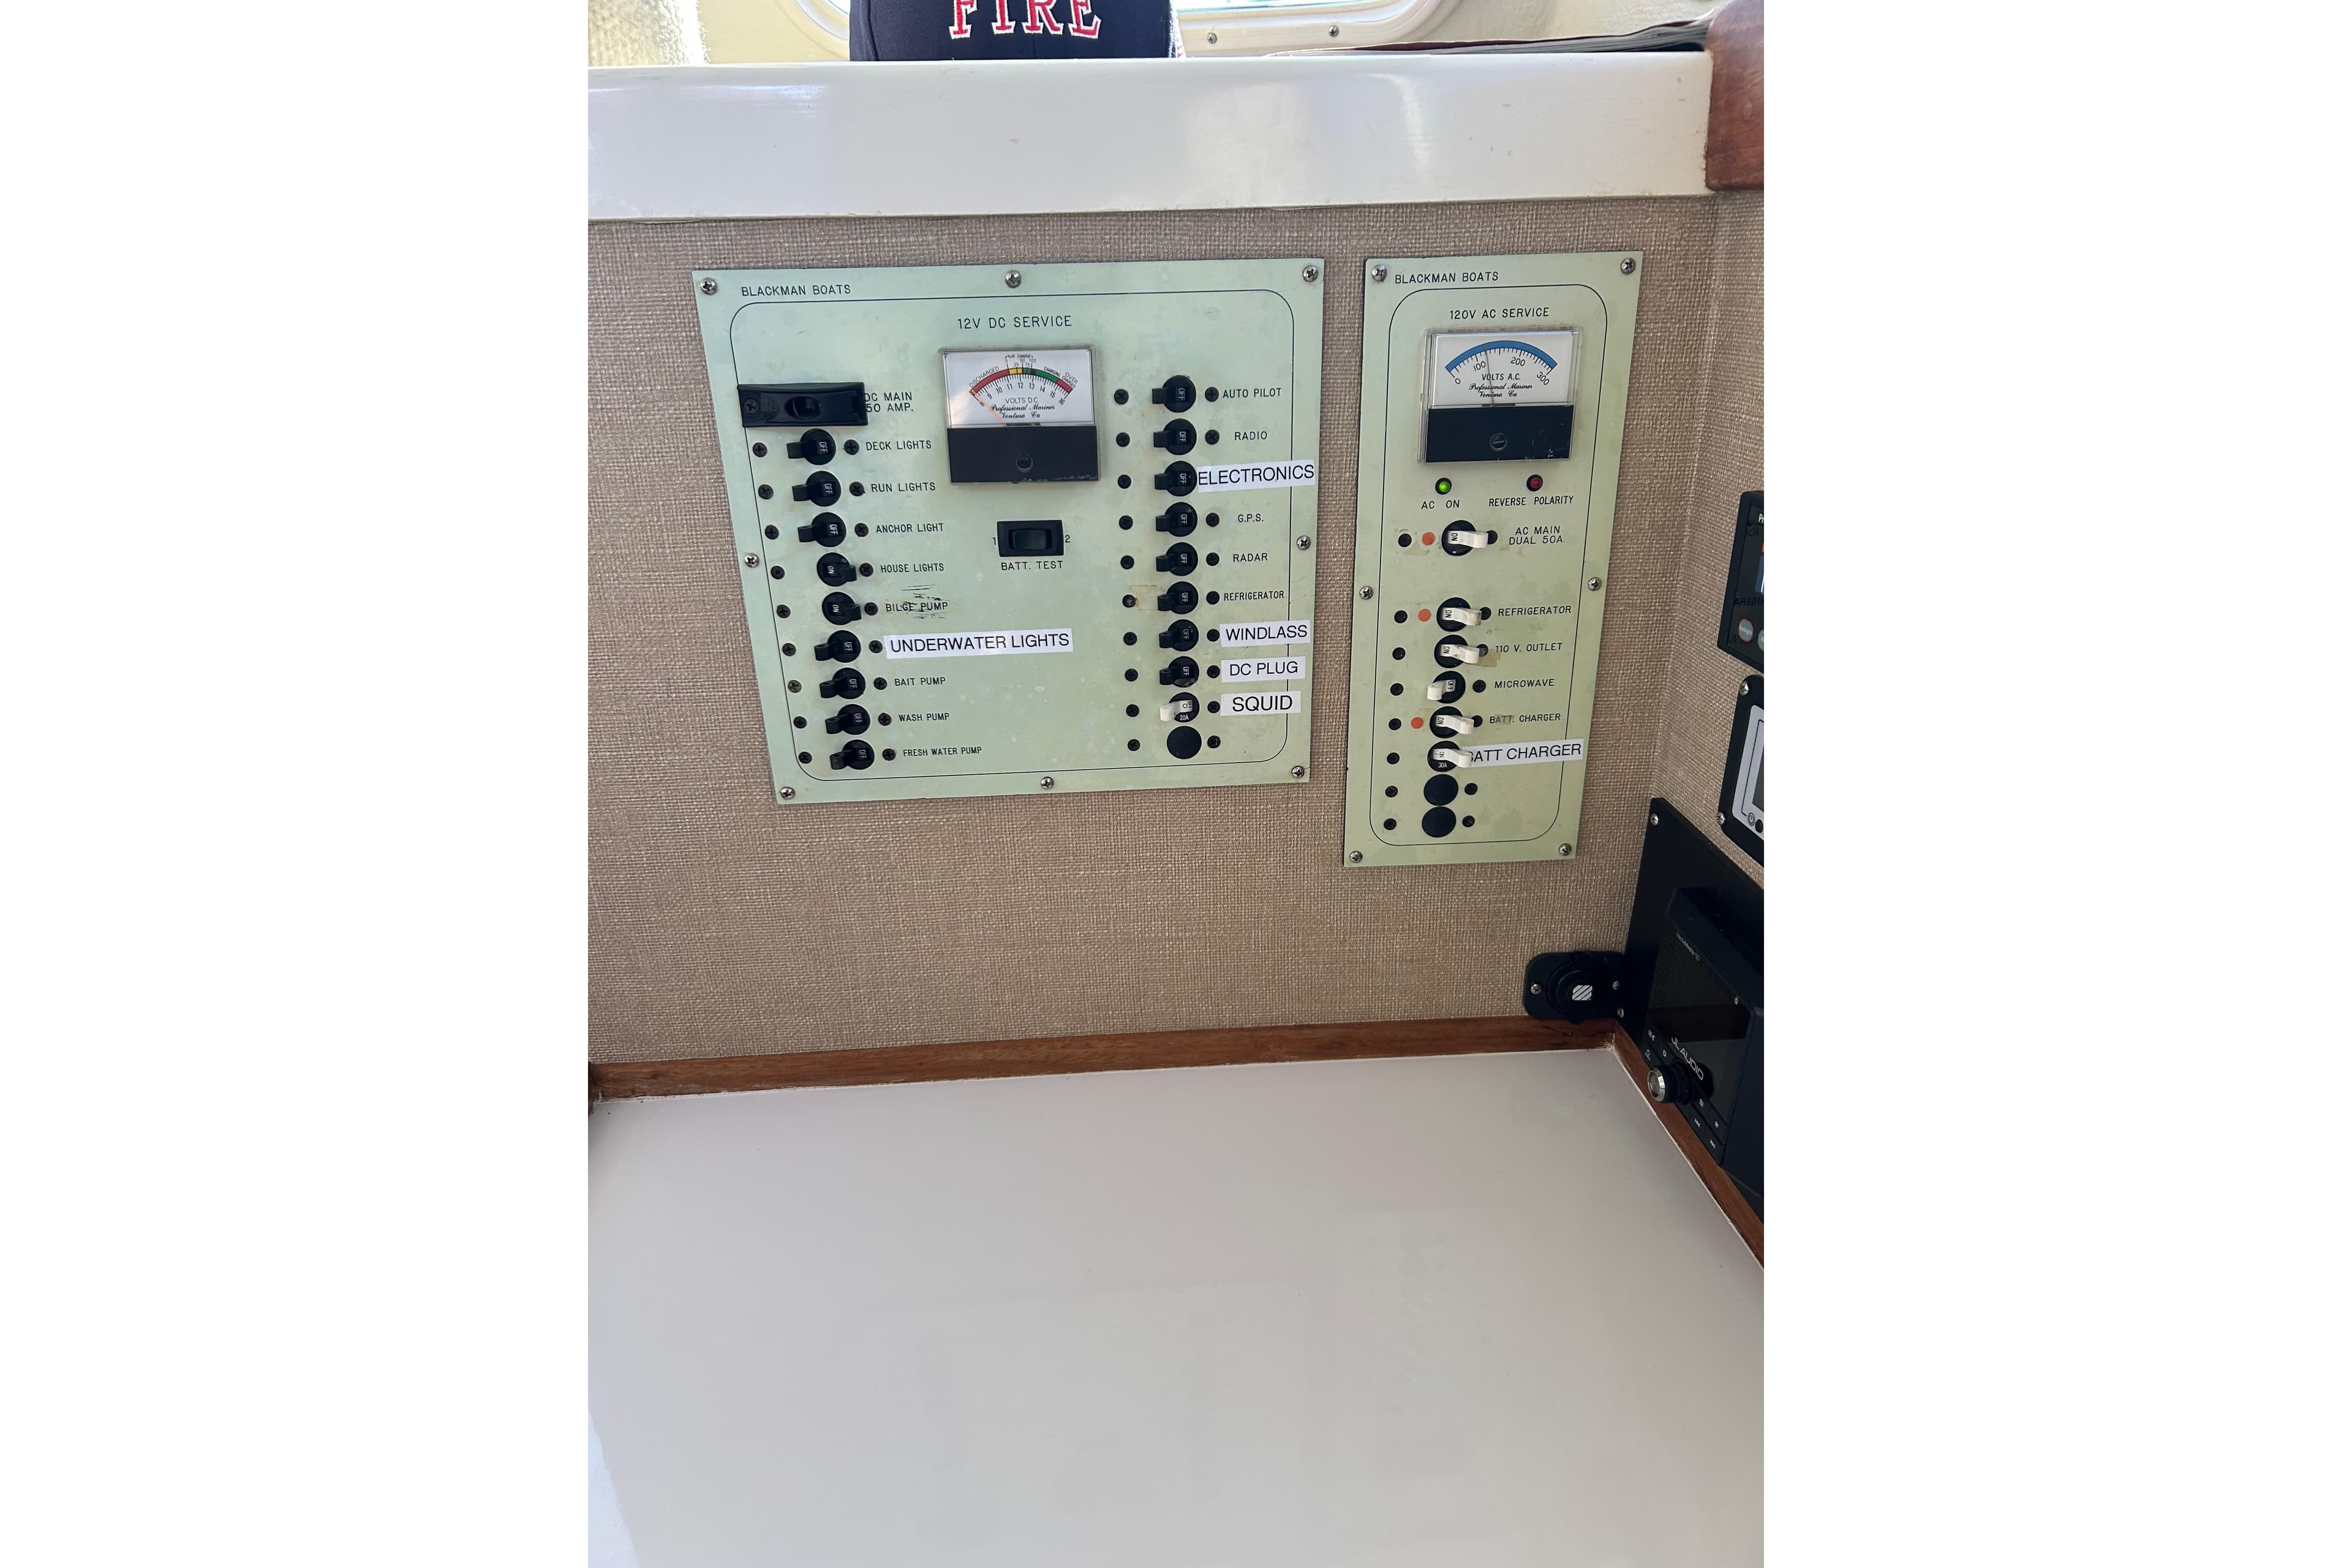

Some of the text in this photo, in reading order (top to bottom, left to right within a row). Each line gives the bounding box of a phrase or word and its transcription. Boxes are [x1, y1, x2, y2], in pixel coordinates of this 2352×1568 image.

[949, 0, 1102, 39] FIRE
[1395, 271, 1499, 284] BLACKMAN BOATS
[741, 284, 851, 297] BLACKMAN BOATS
[1450, 307, 1550, 320] 120V AC SERVICE
[957, 315, 1072, 329] 12V DC SERVICE
[1473, 361, 1486, 371] 100
[1510, 356, 1526, 366] 200
[969, 366, 1000, 388] DISCHARGED
[1065, 372, 1079, 385] OVER
[1536, 371, 1550, 385] 300
[1469, 383, 1507, 392] Professional
[864, 391, 913, 402] DC MAIN
[1223, 388, 1282, 398] AUTO PILOT
[887, 402, 914, 412] AMP.
[990, 404, 1028, 412] Professional
[1234, 431, 1267, 440] RADIO
[819, 441, 828, 453] OFF
[866, 440, 932, 451] DECK LIGHTS
[1198, 464, 1314, 486] ELECTRONICS
[824, 483, 833, 495] OFF
[871, 482, 936, 492] RUN LIGHTS
[1421, 500, 1460, 510] AC ON
[1489, 495, 1574, 507] REVERSE POLARITY
[1238, 513, 1264, 522] G.P.S.
[829, 524, 839, 535] OFF
[876, 522, 944, 533] ANCHOR LIGHT
[1515, 526, 1560, 535] AC MAIN
[992, 537, 997, 545] 1
[1065, 534, 1071, 543] 2
[1451, 532, 1458, 541] ON
[1509, 537, 1536, 545] DUAL
[1233, 552, 1268, 562] RADAR
[827, 565, 835, 575] ON
[881, 563, 944, 573] HOUSE LIGHTS
[1001, 560, 1063, 570] BATT. TEST
[1224, 590, 1284, 601] REFRIGERATOR
[832, 604, 839, 613] ON
[886, 601, 949, 612] BILGE PUMP
[1498, 606, 1572, 616] REFRIGERATOR
[1445, 609, 1452, 618] ON
[1226, 624, 1308, 641] WINDLASS
[891, 633, 1070, 653] UNDERWATER LIGHTS
[1526, 643, 1563, 652] OUTLET
[1442, 646, 1450, 655] ON
[1230, 661, 1298, 676] DC PLUG
[849, 678, 858, 688] OFF
[895, 677, 946, 687] BAIT PUMP
[1494, 679, 1555, 689] MICROWAVE
[1232, 695, 1293, 712] SQUID
[854, 713, 862, 723] OFF
[899, 712, 950, 722] WASH PUMP
[1437, 717, 1444, 725] ON
[1490, 713, 1561, 724] BATT. CHARGER
[903, 746, 982, 757] FRESH WATER PUMP
[1507, 743, 1581, 760] CHARGER
[1679, 1047, 1704, 1080] AUDIO
